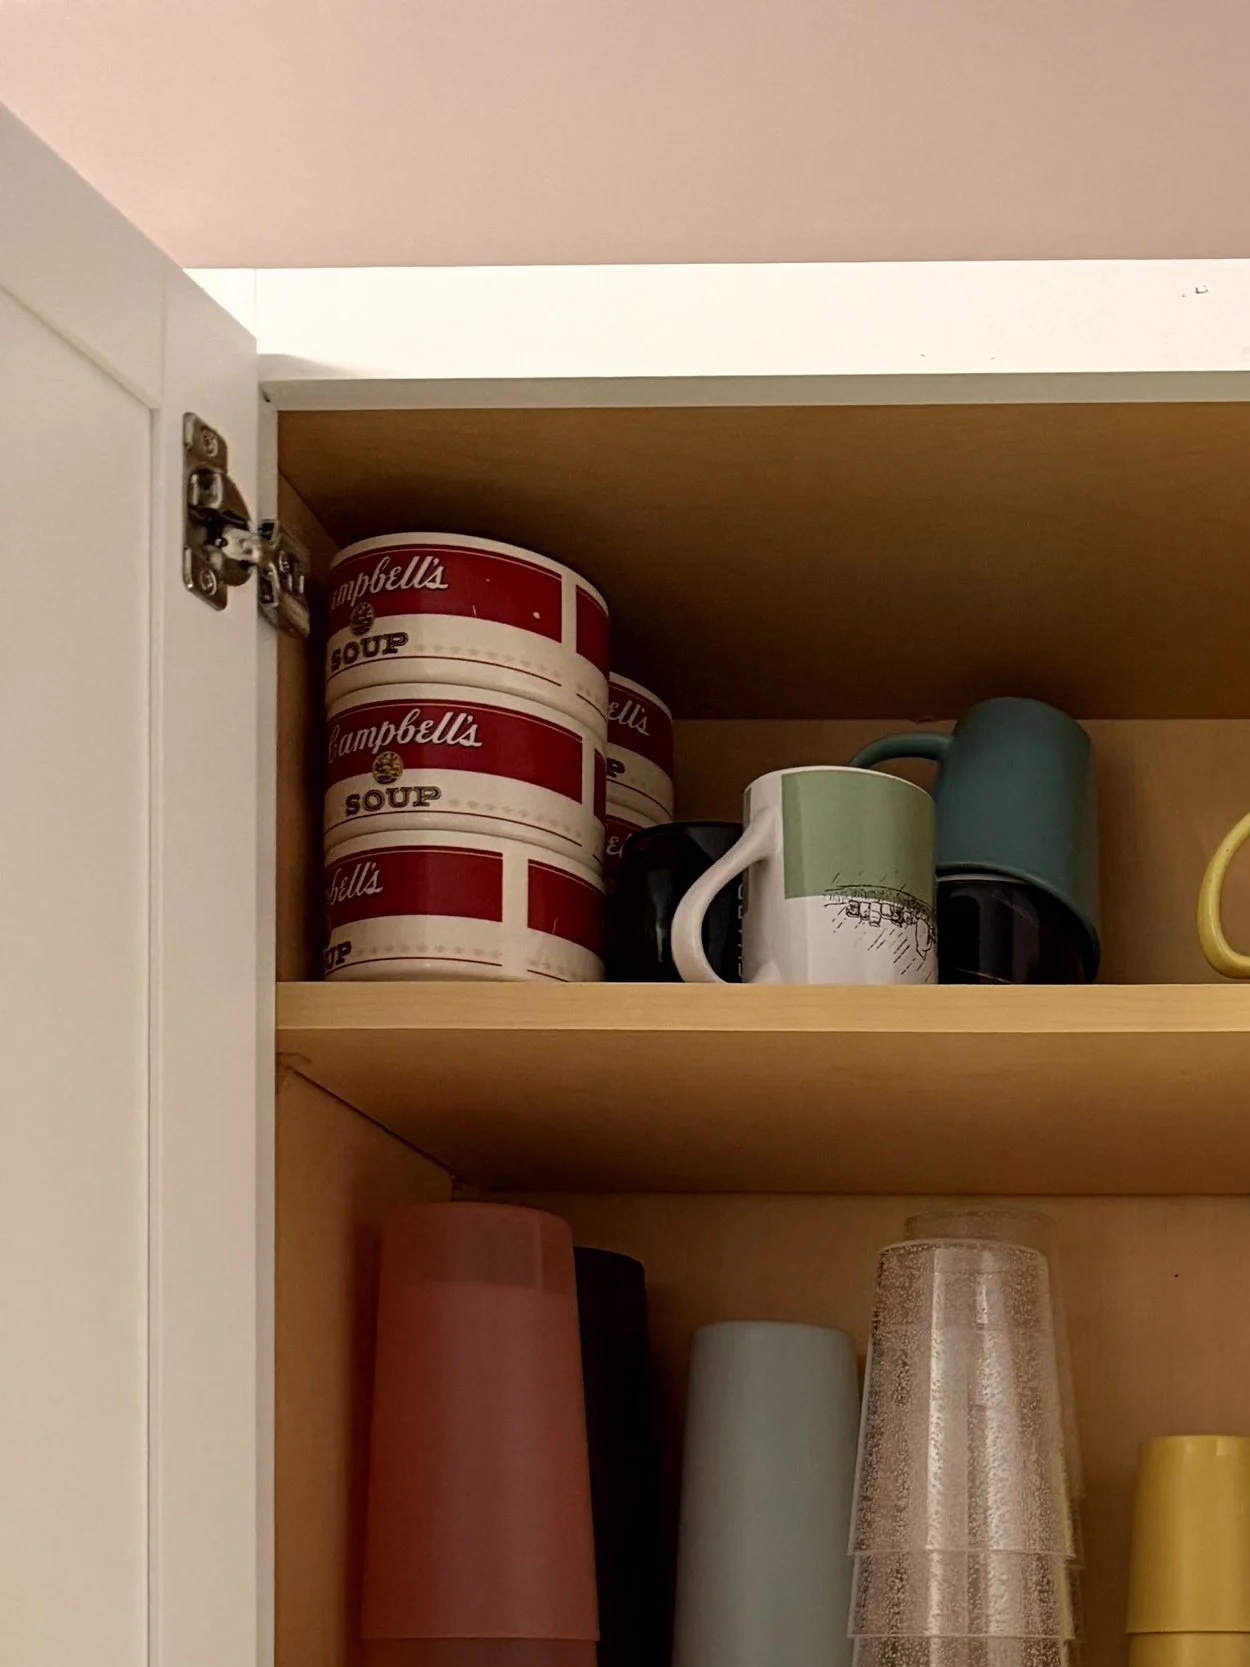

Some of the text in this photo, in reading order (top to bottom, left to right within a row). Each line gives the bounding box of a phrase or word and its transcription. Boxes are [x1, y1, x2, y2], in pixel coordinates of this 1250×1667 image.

[331, 631, 409, 673] SOUP
[328, 707, 484, 764] Campbell's
[608, 699, 650, 737] ell's
[345, 785, 442, 817] SOUP
[330, 861, 384, 907] bell's
